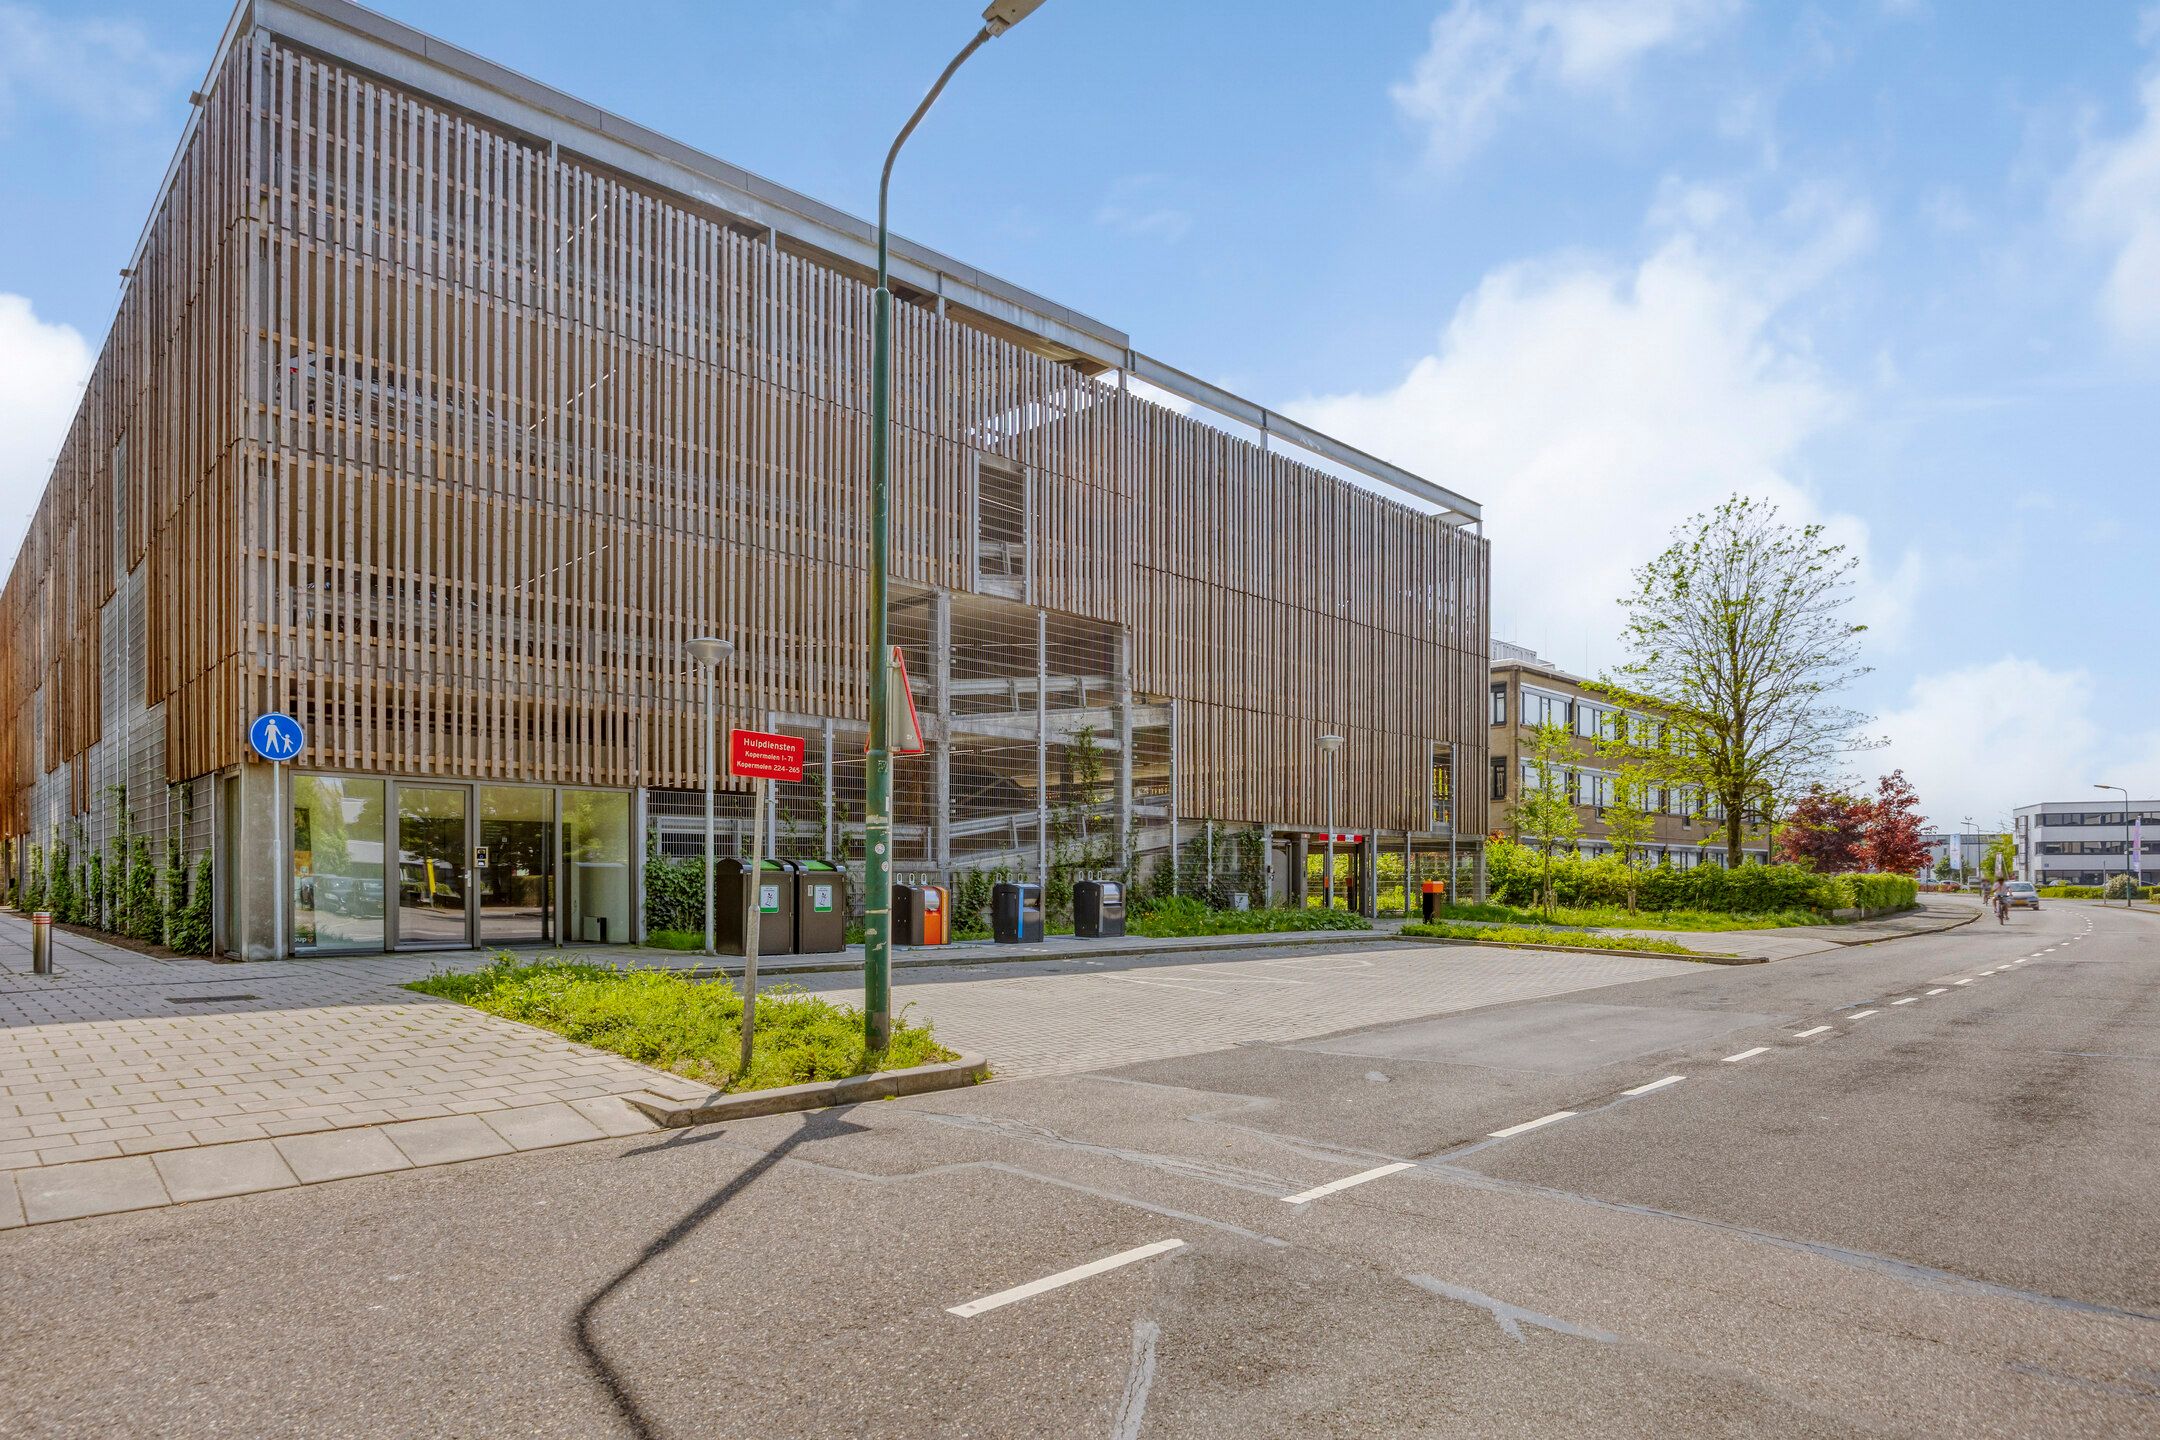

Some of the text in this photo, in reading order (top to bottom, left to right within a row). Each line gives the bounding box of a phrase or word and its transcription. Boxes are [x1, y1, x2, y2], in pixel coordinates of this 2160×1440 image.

[744, 738, 795, 752] Hulpdiensten
[745, 751, 780, 761] Kopermolen
[736, 761, 772, 771] Kopermolen
